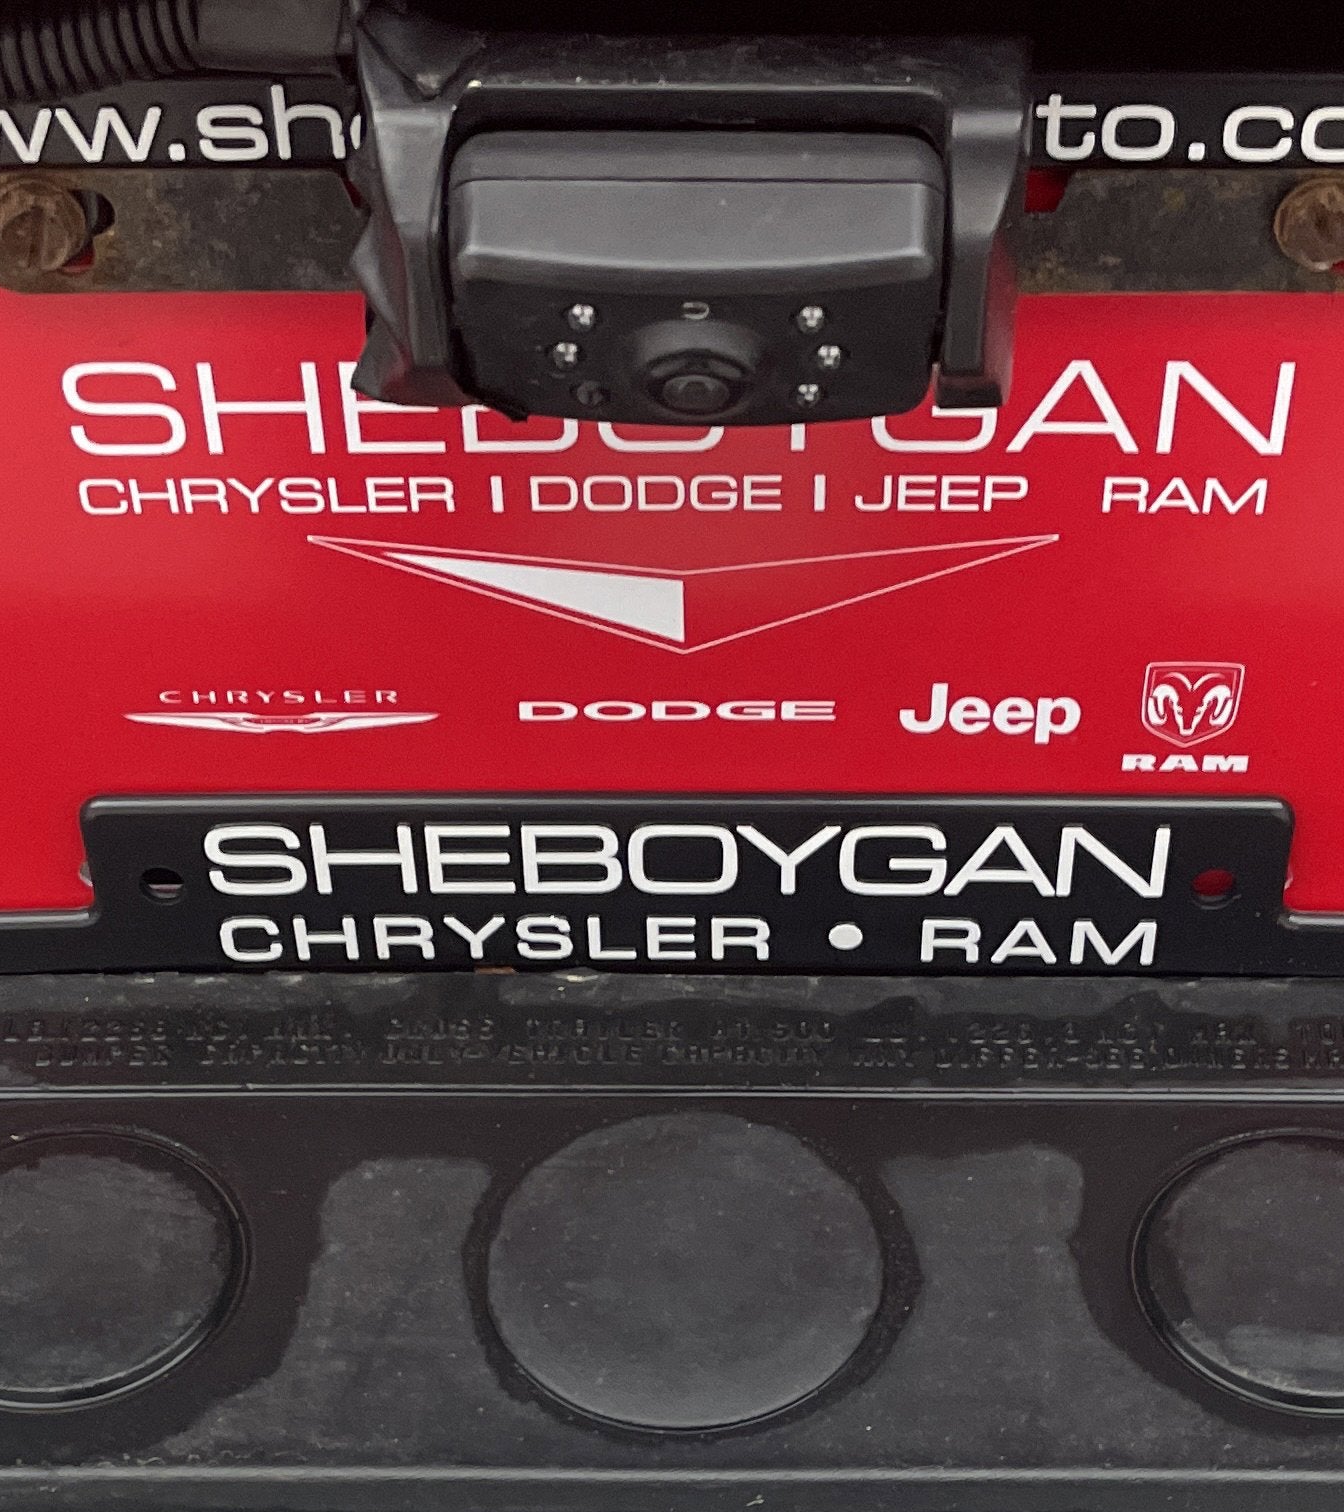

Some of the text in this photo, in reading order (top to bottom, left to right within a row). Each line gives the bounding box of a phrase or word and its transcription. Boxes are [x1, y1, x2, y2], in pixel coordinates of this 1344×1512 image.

[78, 475, 1268, 515] CHRYSLER DODGE JEEP RAM
[158, 689, 398, 705] CHRYSLER
[518, 700, 837, 722] DODGE
[899, 682, 1081, 745] Jeep
[1120, 753, 1250, 773] RAM
[203, 824, 1171, 898] SHEBOYGAN
[219, 914, 1158, 966] CHRYSLER RAM
